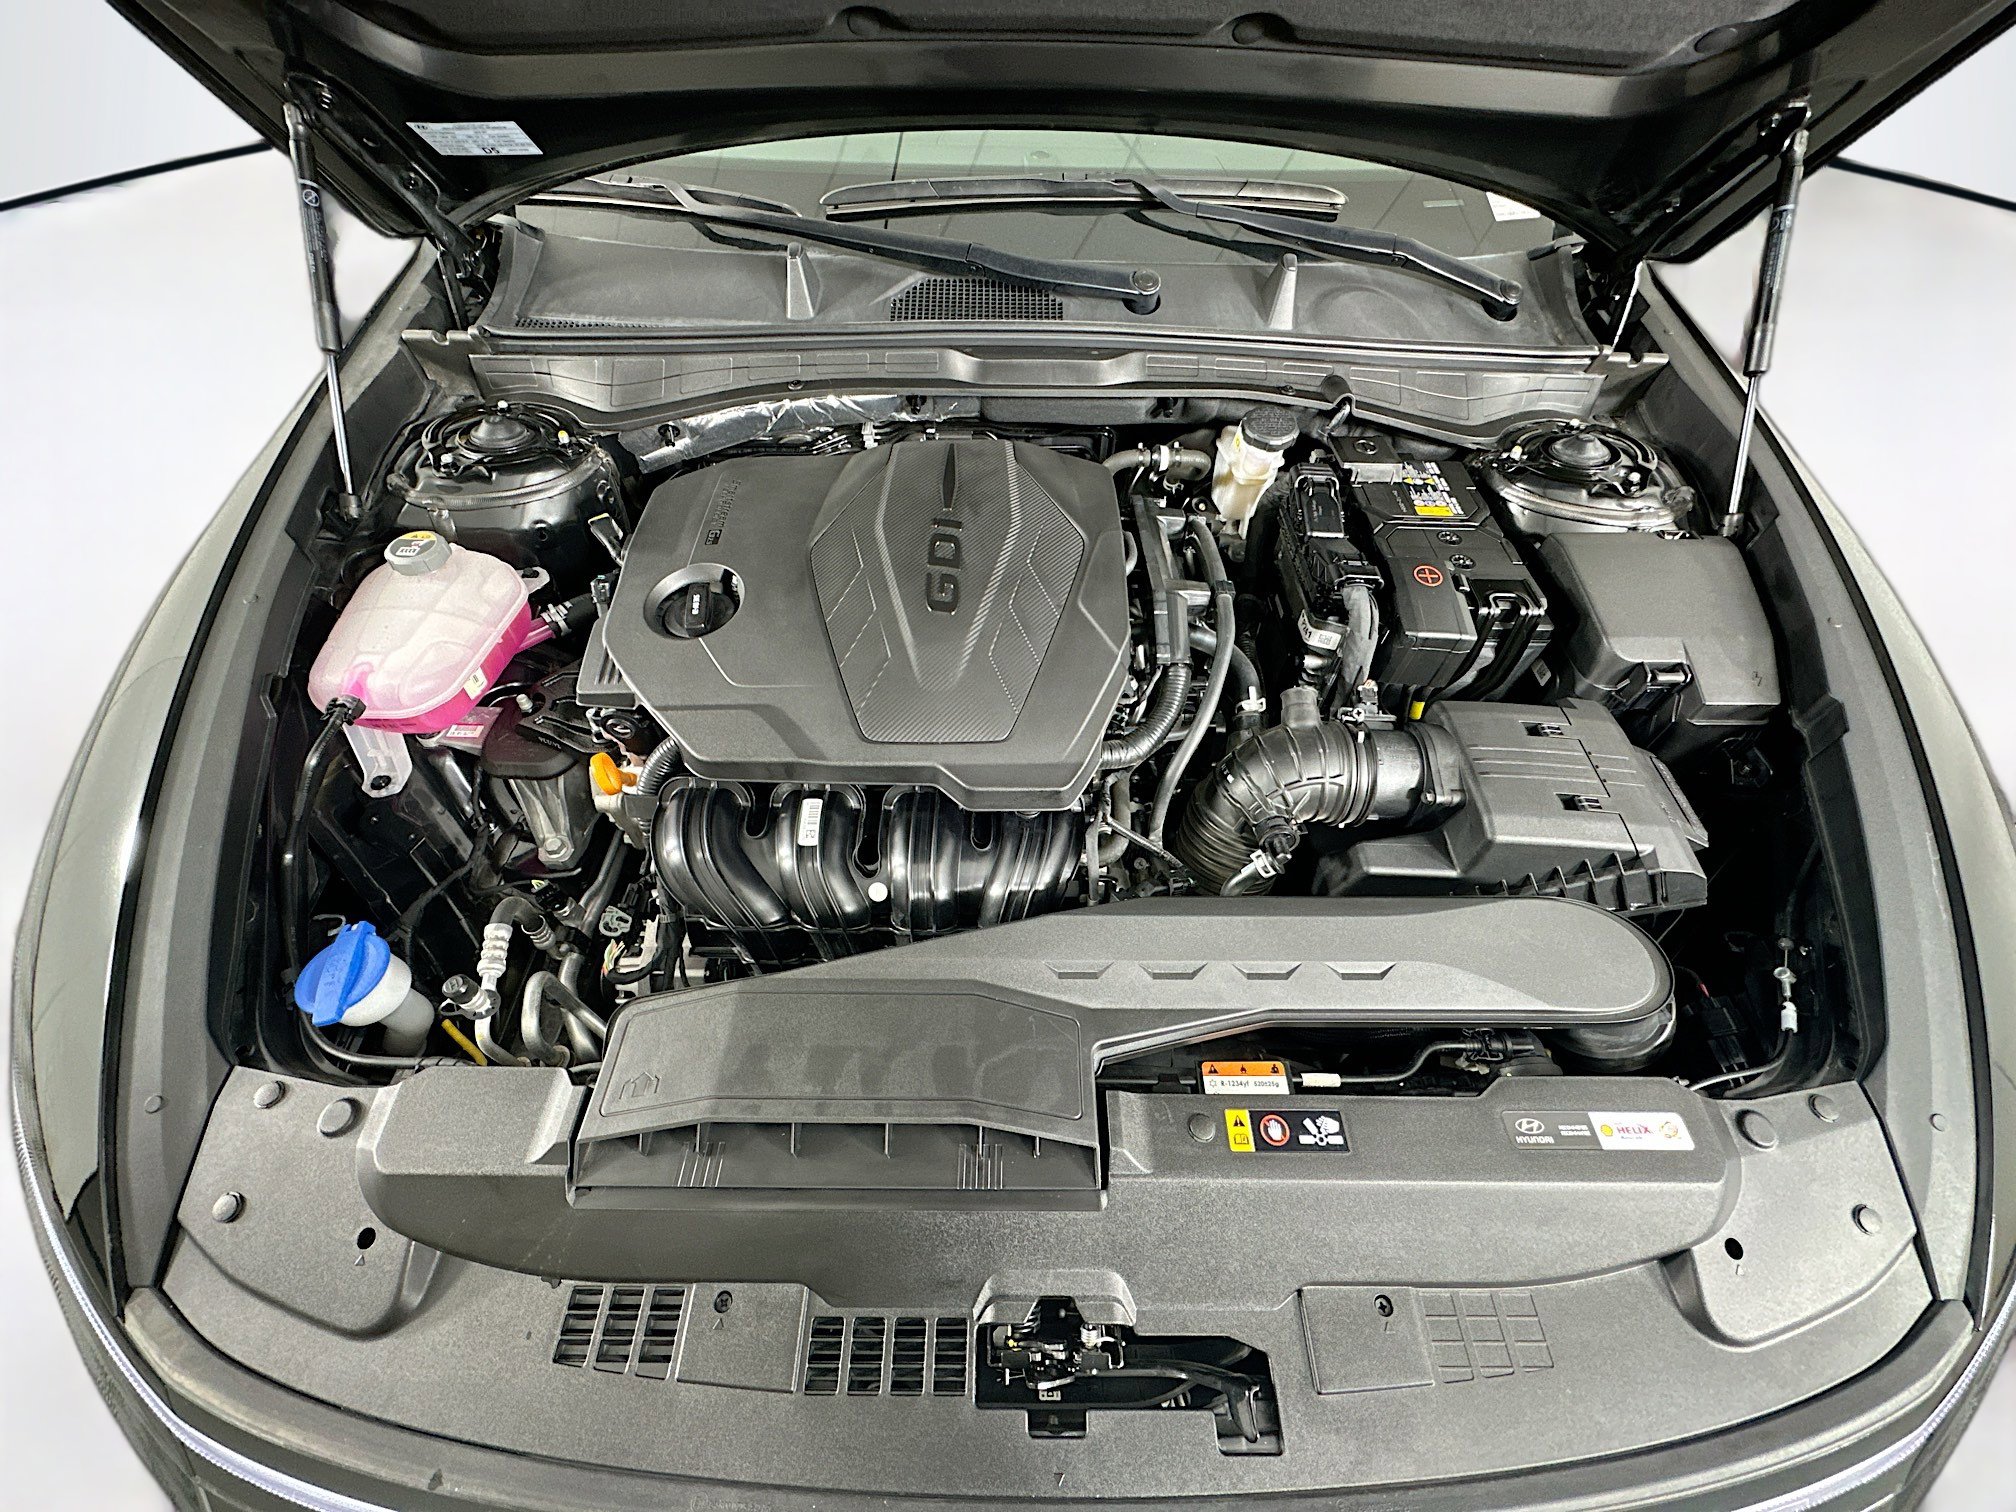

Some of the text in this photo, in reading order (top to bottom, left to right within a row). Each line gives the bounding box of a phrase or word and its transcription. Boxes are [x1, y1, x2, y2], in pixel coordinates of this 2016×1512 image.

[926, 518, 962, 614] GDI
[1220, 1080, 1250, 1088] R-1234yf
[1616, 1126, 1651, 1134] HELIX
[1515, 1135, 1555, 1144] HYUNDAI
